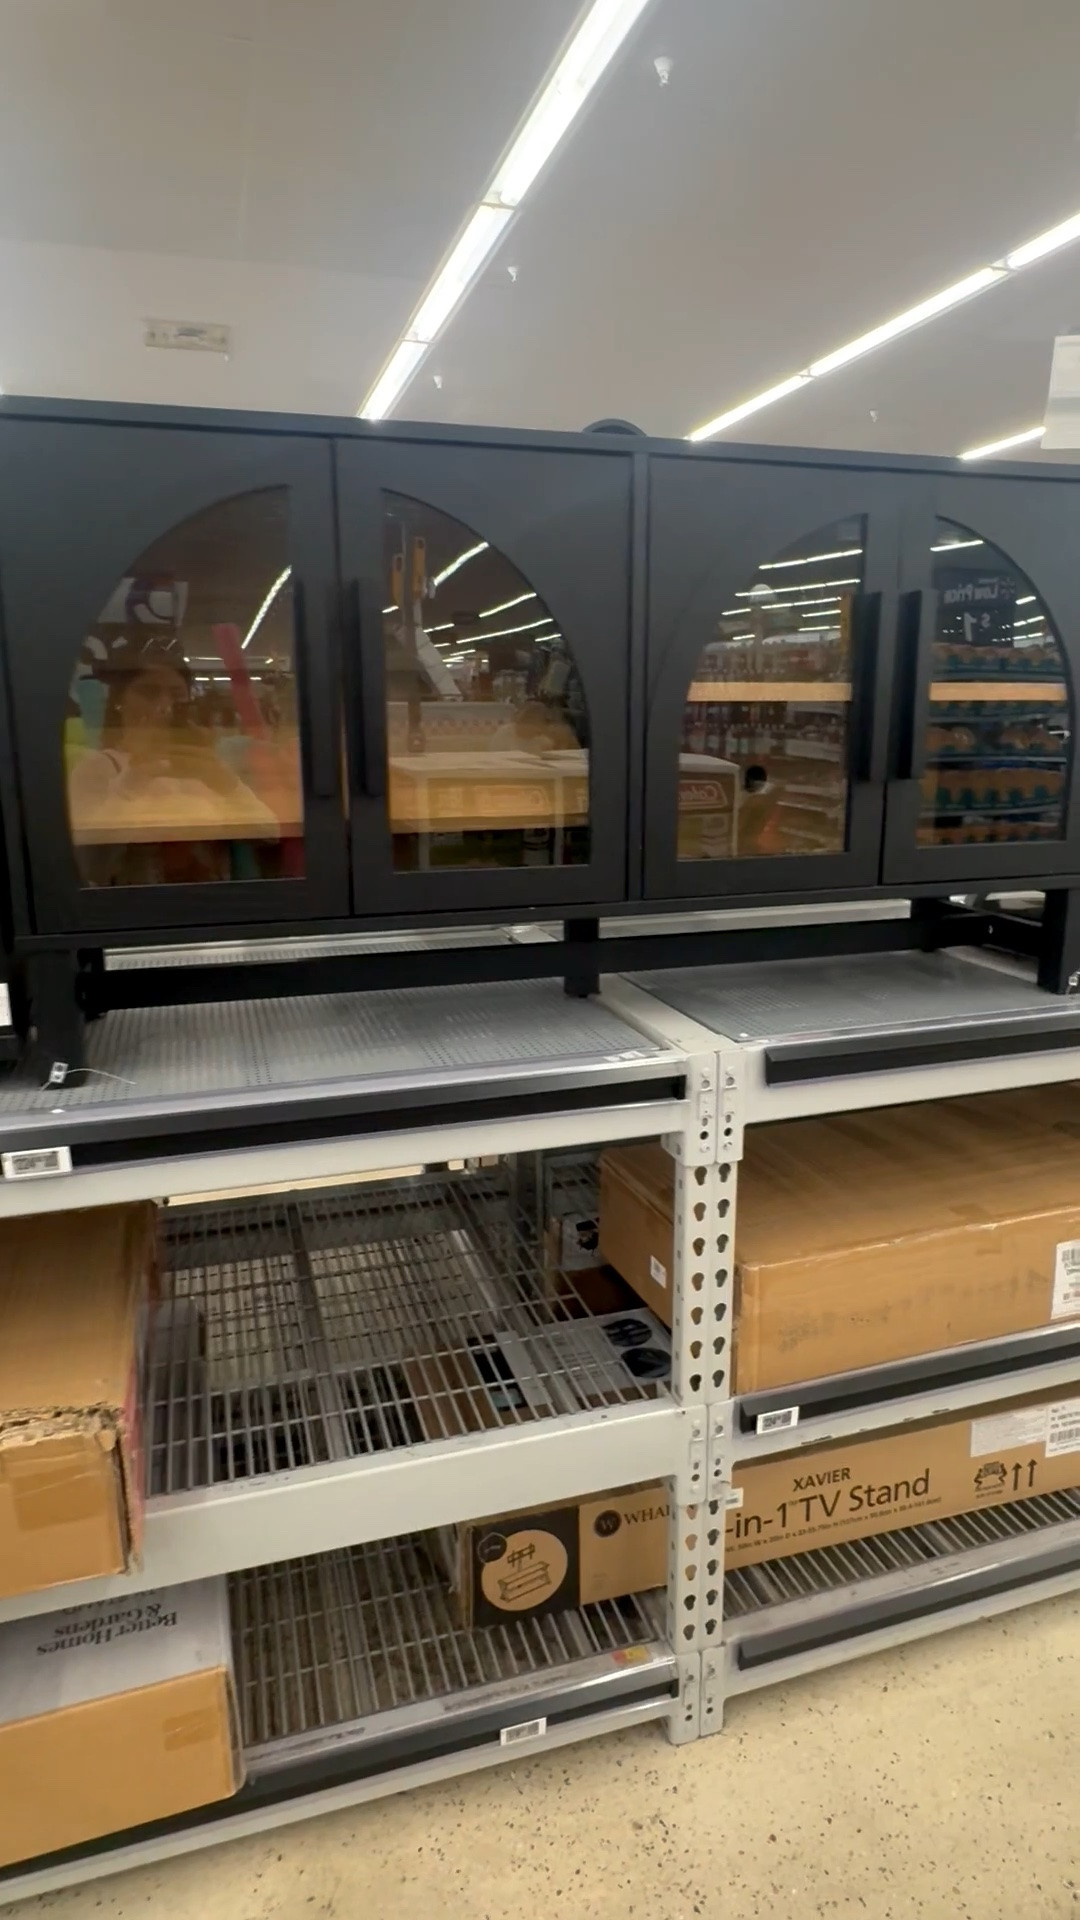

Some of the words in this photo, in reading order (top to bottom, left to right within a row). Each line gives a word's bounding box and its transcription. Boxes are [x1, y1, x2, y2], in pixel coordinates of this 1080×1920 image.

[792, 1466, 851, 1492] XAVIER
[725, 1502, 787, 1538] -in-1
[799, 1489, 841, 1523] TV
[849, 1468, 930, 1512] Stand
[54, 1608, 143, 1637] Gardens
[115, 1611, 177, 1637] Better
[147, 1603, 161, 1618] &
[36, 1628, 112, 1656] Homes
